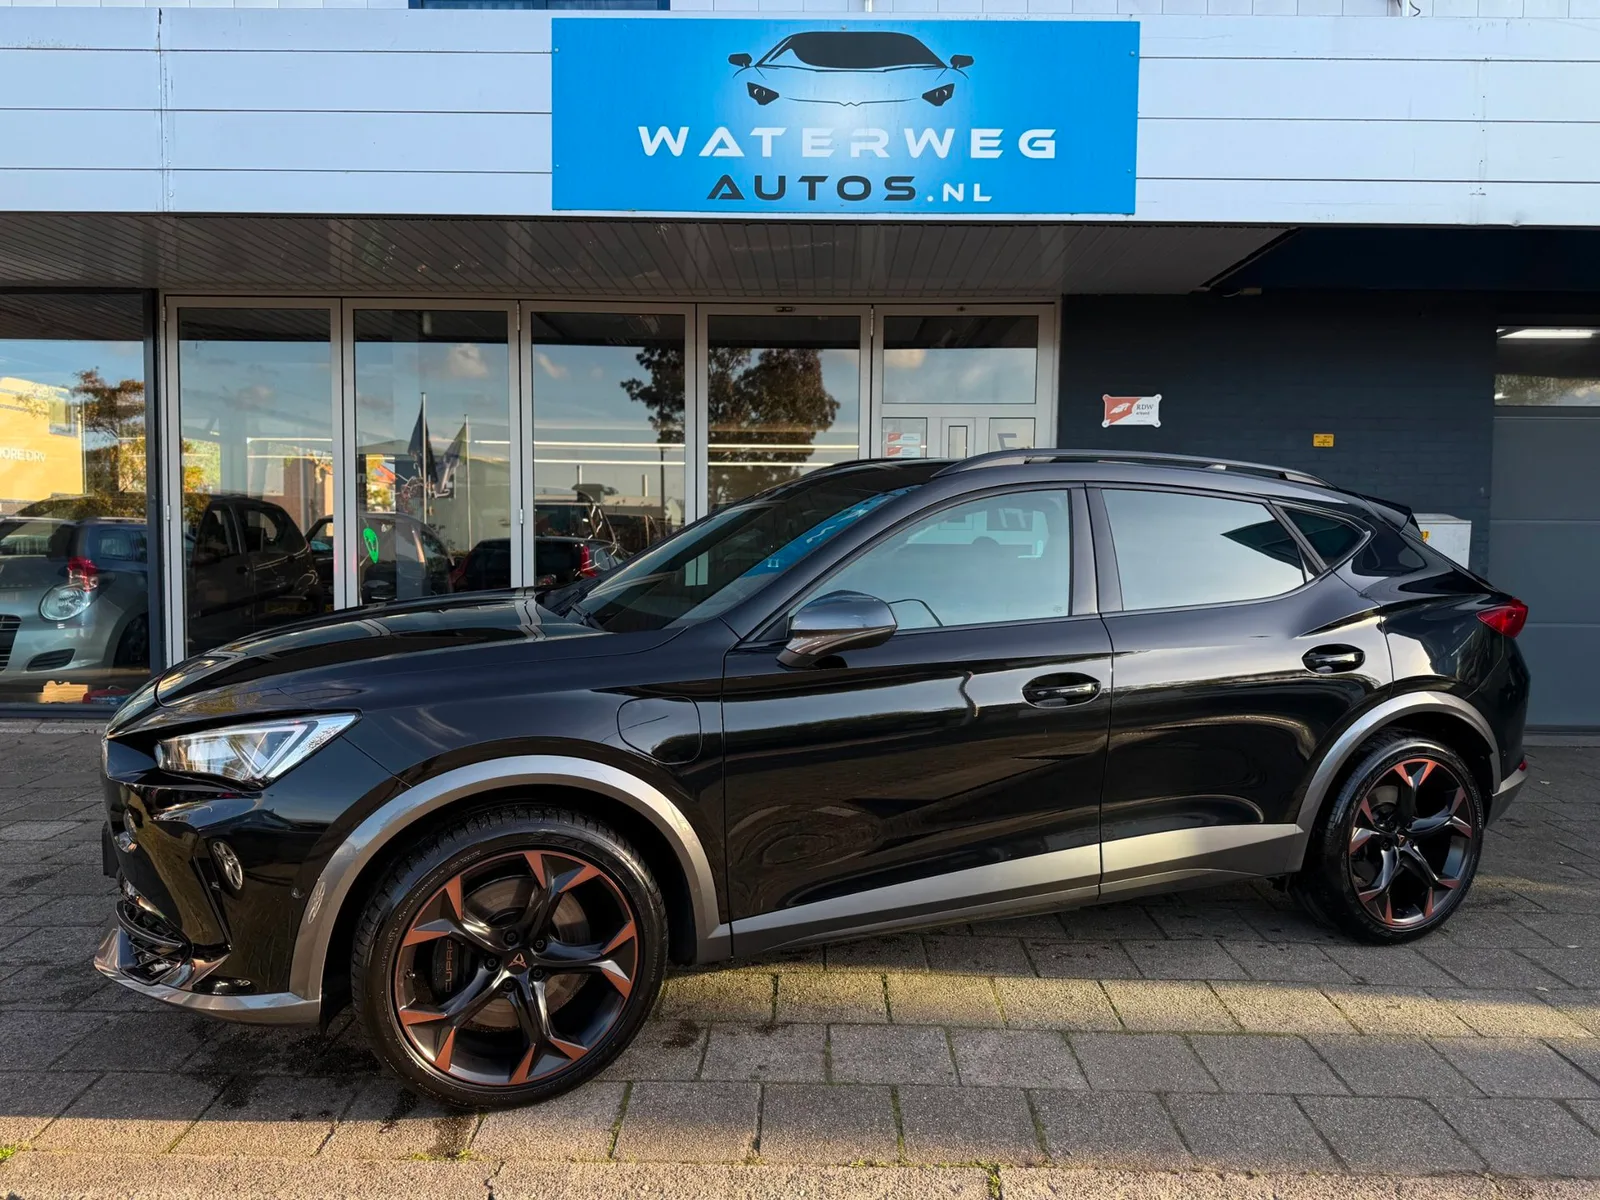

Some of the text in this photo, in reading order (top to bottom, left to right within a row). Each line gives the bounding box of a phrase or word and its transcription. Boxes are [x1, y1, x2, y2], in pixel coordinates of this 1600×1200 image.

[637, 126, 1057, 160] WATERWEG
[706, 174, 993, 203] AUTOS.NL
[445, 939, 453, 993] CUPRA
